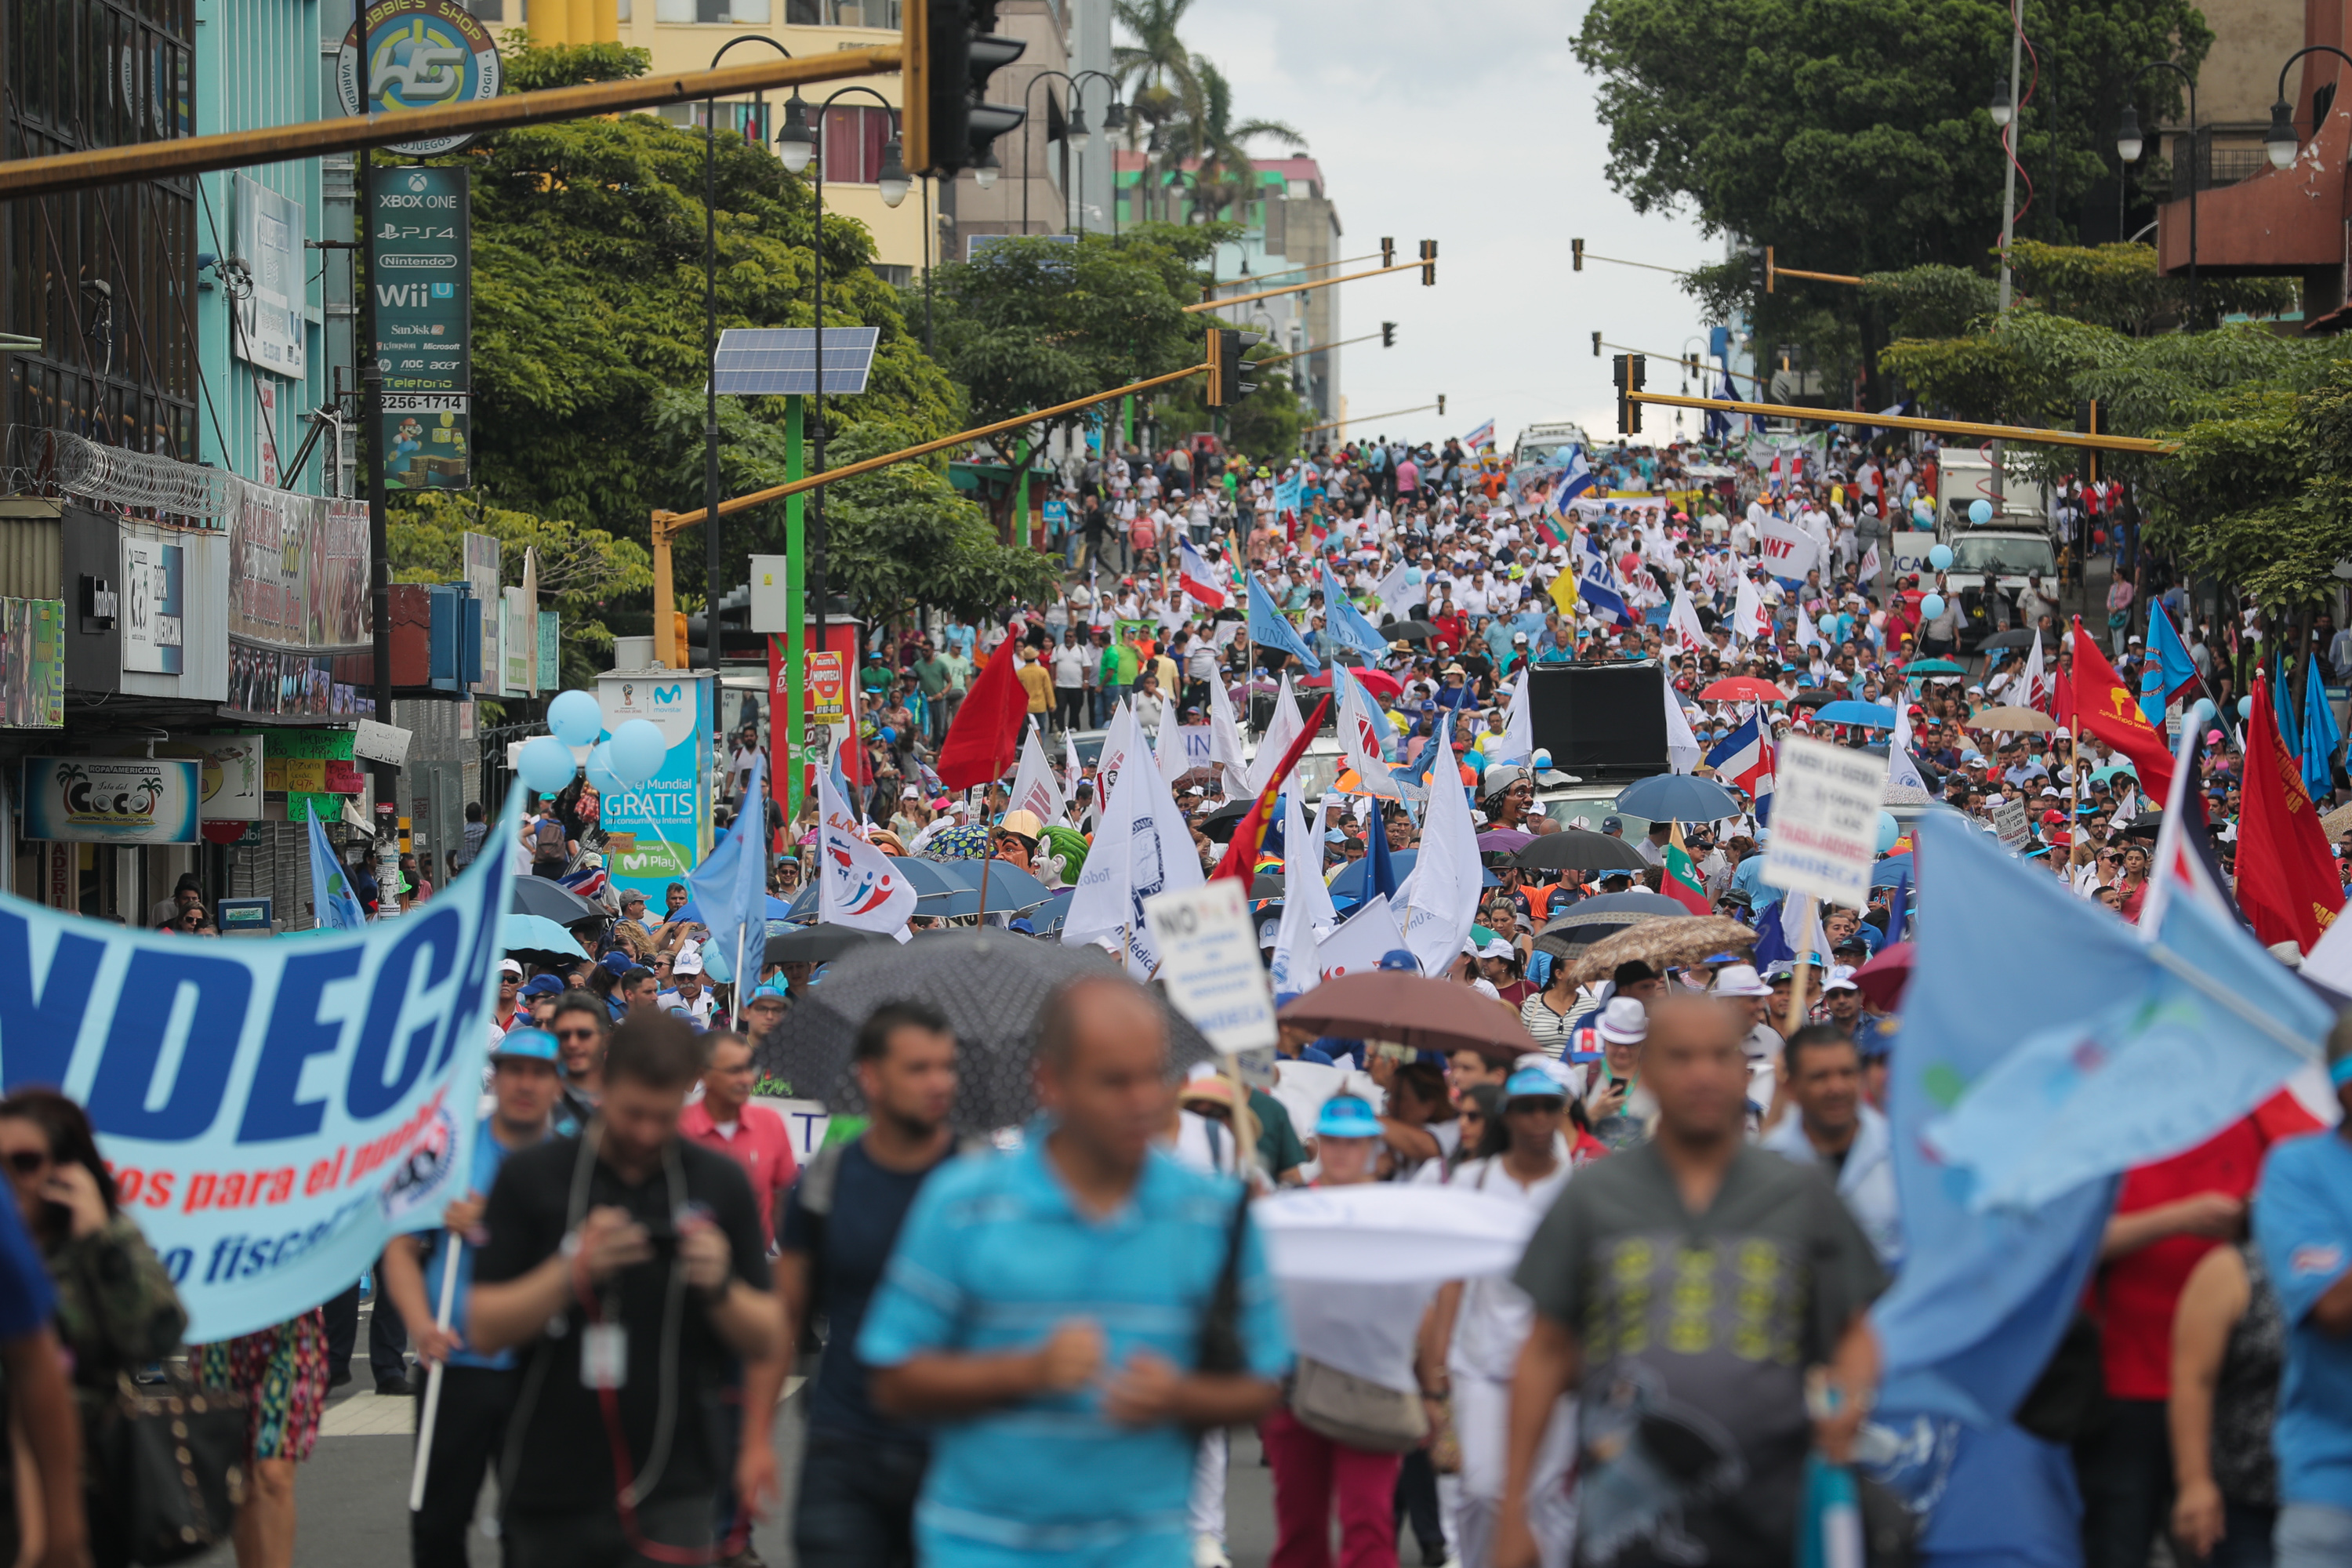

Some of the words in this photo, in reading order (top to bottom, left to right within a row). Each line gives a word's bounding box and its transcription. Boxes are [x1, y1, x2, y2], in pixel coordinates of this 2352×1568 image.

[438, 2, 481, 40] SHOP
[410, 136, 452, 151] JUEGOS
[379, 195, 423, 208] XBOX
[426, 196, 457, 209] ONE
[402, 227, 455, 238] PS4
[376, 283, 428, 307] Wii
[436, 283, 450, 296] U
[391, 325, 430, 336] SanDisk
[383, 341, 416, 350] Kingston
[400, 360, 423, 368] AOC
[429, 361, 460, 370] acer
[380, 397, 462, 409] 2256-1714
[812, 670, 840, 682] HIPOTECA
[97, 782, 114, 791] Isla
[647, 779, 691, 789] Mundial
[604, 793, 693, 816] GRATIS
[1994, 810, 2006, 819] PAREN
[2010, 801, 2023, 812] GUERRA
[2009, 811, 2024, 822] CONTRA
[2013, 818, 2023, 827] LOS
[1999, 826, 2027, 842] TRABAJADORES
[651, 855, 677, 870] Play
[182, 1165, 296, 1215] para
[303, 1145, 347, 1198] el
